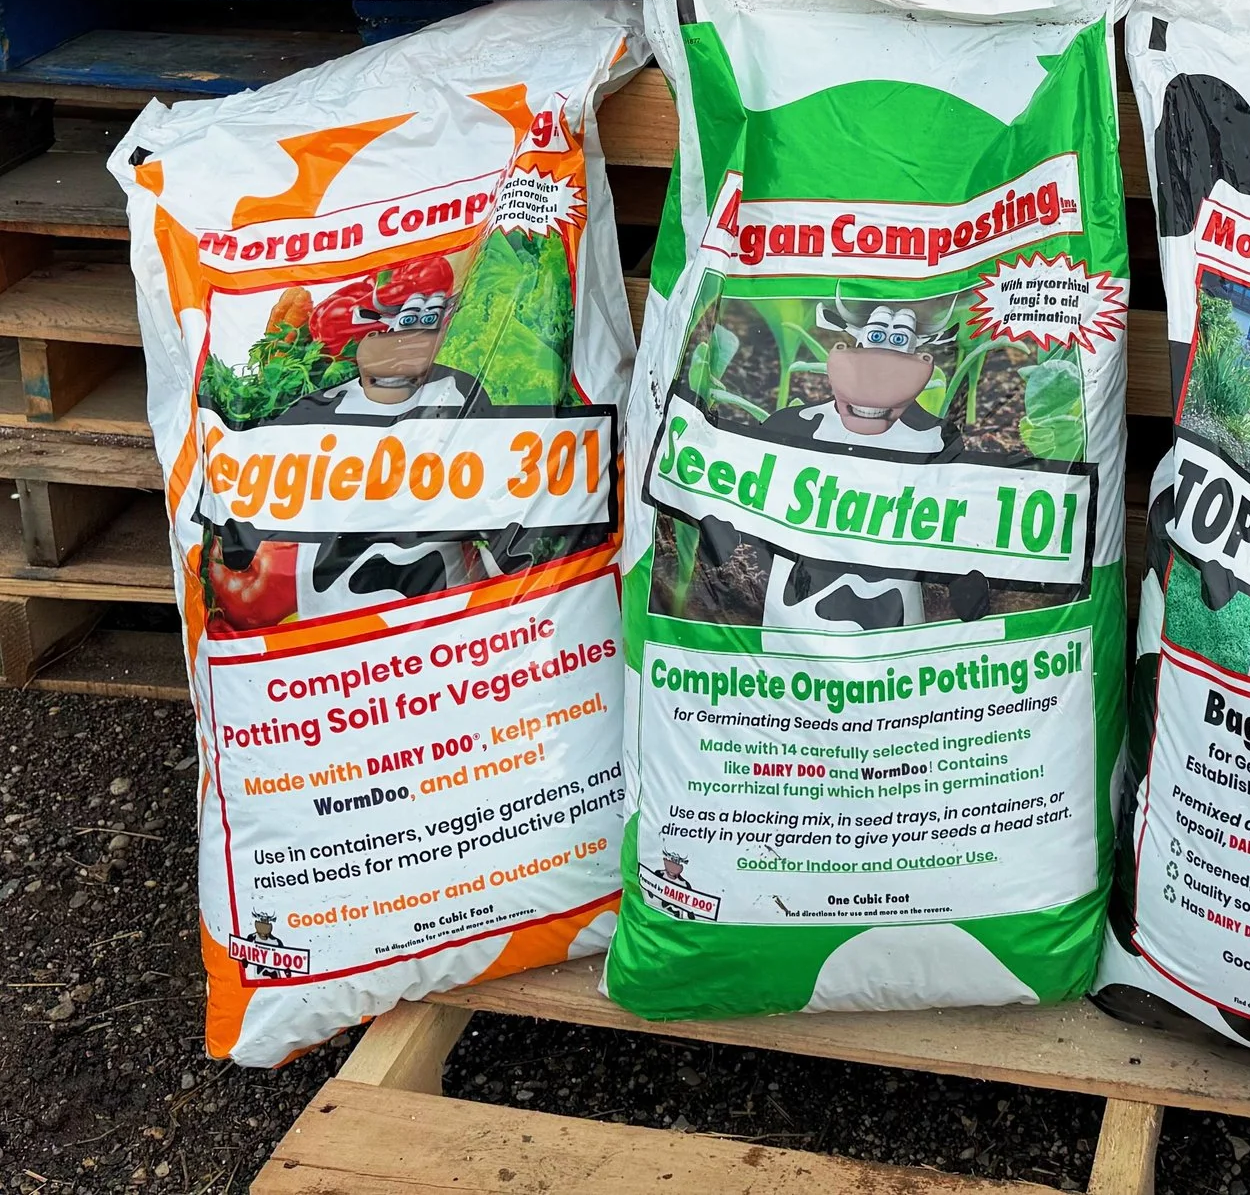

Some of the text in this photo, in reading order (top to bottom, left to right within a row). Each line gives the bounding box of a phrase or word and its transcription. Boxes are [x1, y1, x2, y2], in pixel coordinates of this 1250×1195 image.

[537, 182, 559, 193] with
[495, 211, 549, 224] produce!
[508, 200, 558, 213] flavorful
[830, 181, 1061, 266] Composting
[199, 224, 363, 261] Morgan
[1001, 278, 1089, 293] With mycorrhizal
[1009, 293, 1079, 308] fungi to aid
[1003, 310, 1082, 325] germination!
[507, 429, 600, 499] 301
[659, 417, 1077, 554] Seed Starter 101
[267, 615, 554, 702] Complete Organic
[222, 639, 616, 748] Potting Soil for Vegetables
[651, 640, 1082, 714] Complete Organic Potting Soil
[674, 696, 1058, 732] for Germinating Seeds and Transplanting Seedlings
[244, 773, 305, 796] Made
[309, 762, 363, 787] with
[366, 746, 425, 776] DAIRY
[491, 718, 541, 745] kelp
[546, 693, 607, 727] meal,
[700, 728, 1031, 764] Made with 14 carefully selected ingredients
[1208, 742, 1233, 764] for
[313, 743, 545, 816] WormDoo, and more!
[254, 761, 622, 865] Use in containers, veggie gardens, and
[1172, 784, 1242, 828] Premixed
[737, 850, 998, 872] Good for Indoor and Outdoor Use.
[827, 893, 910, 905] One Cubic Foot
[413, 904, 494, 932] One Cubic Foot
[231, 942, 268, 965] DAIRY
